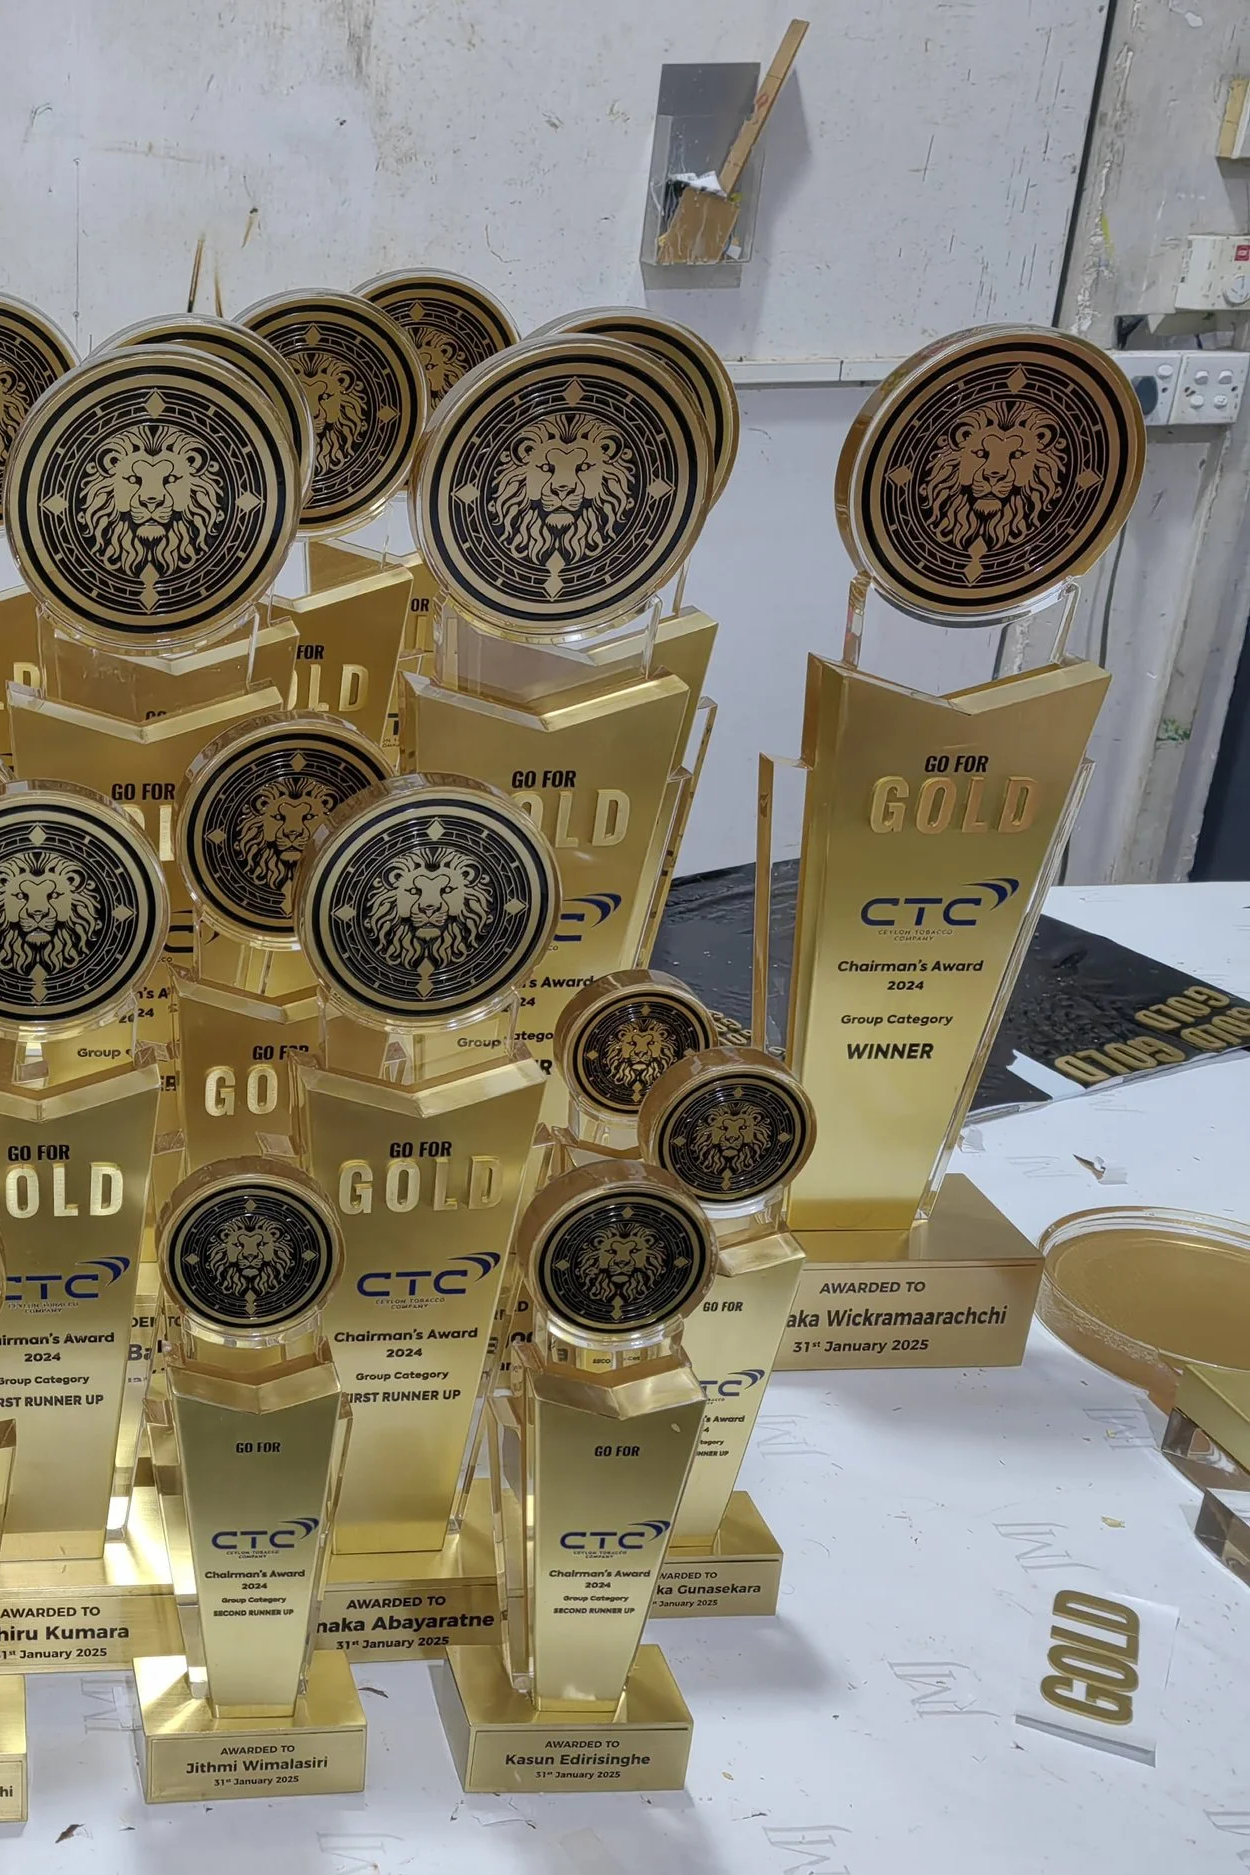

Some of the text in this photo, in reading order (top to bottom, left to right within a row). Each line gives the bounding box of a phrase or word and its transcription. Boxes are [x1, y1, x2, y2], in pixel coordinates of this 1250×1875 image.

[296, 644, 325, 660] FOR
[924, 755, 989, 773] GO FOR
[511, 770, 577, 789] GO FOR
[111, 782, 176, 801] GO FOR
[869, 776, 1041, 834] GOLD
[860, 897, 983, 927] CTC
[837, 959, 984, 972] Chairman's Award
[886, 980, 924, 991] 2024
[1135, 985, 1230, 1032] GOLD
[840, 1013, 954, 1027] Group Category
[76, 1047, 122, 1060] Group
[252, 1045, 275, 1061] GO
[846, 1042, 934, 1060] WINNER
[1054, 1036, 1185, 1083] GOLD
[7, 1144, 70, 1162] GO FOR
[389, 1140, 453, 1159] GO FOR
[338, 1156, 503, 1214] GOLD
[356, 1269, 469, 1297] CTC
[818, 1281, 926, 1295] AWARDED TO
[702, 1301, 744, 1313] GO FOR
[826, 1305, 1008, 1328] Wickramaarachchi
[63, 1331, 115, 1344] Award
[333, 1327, 479, 1343] Chairman's Award
[385, 1347, 423, 1358] 2024
[823, 1340, 888, 1354] January
[890, 1339, 930, 1351] 2025
[24, 1351, 62, 1363] 2024
[34, 1375, 90, 1386] Category
[355, 1370, 450, 1382] Group Category
[381, 1389, 440, 1403] RUNNER
[442, 1389, 462, 1400] UP
[235, 1441, 281, 1454] GO FOR
[594, 1445, 641, 1457] GO FOR
[211, 1529, 296, 1550] CTC
[559, 1531, 646, 1550] CTC
[704, 1571, 718, 1579] TO
[677, 1583, 762, 1595] Gunasekara
[345, 1595, 446, 1610] AWARDED TO
[0, 1606, 101, 1619] AWARDED TO
[370, 1613, 495, 1633] Abayaratne
[45, 1625, 129, 1641] Kumara
[361, 1639, 415, 1649] January
[417, 1635, 450, 1647] 2025
[1040, 1589, 1140, 1726] GOLD
[242, 1755, 328, 1772] Wimalasiri
[505, 1753, 651, 1768] Kasun Edirisinghe
